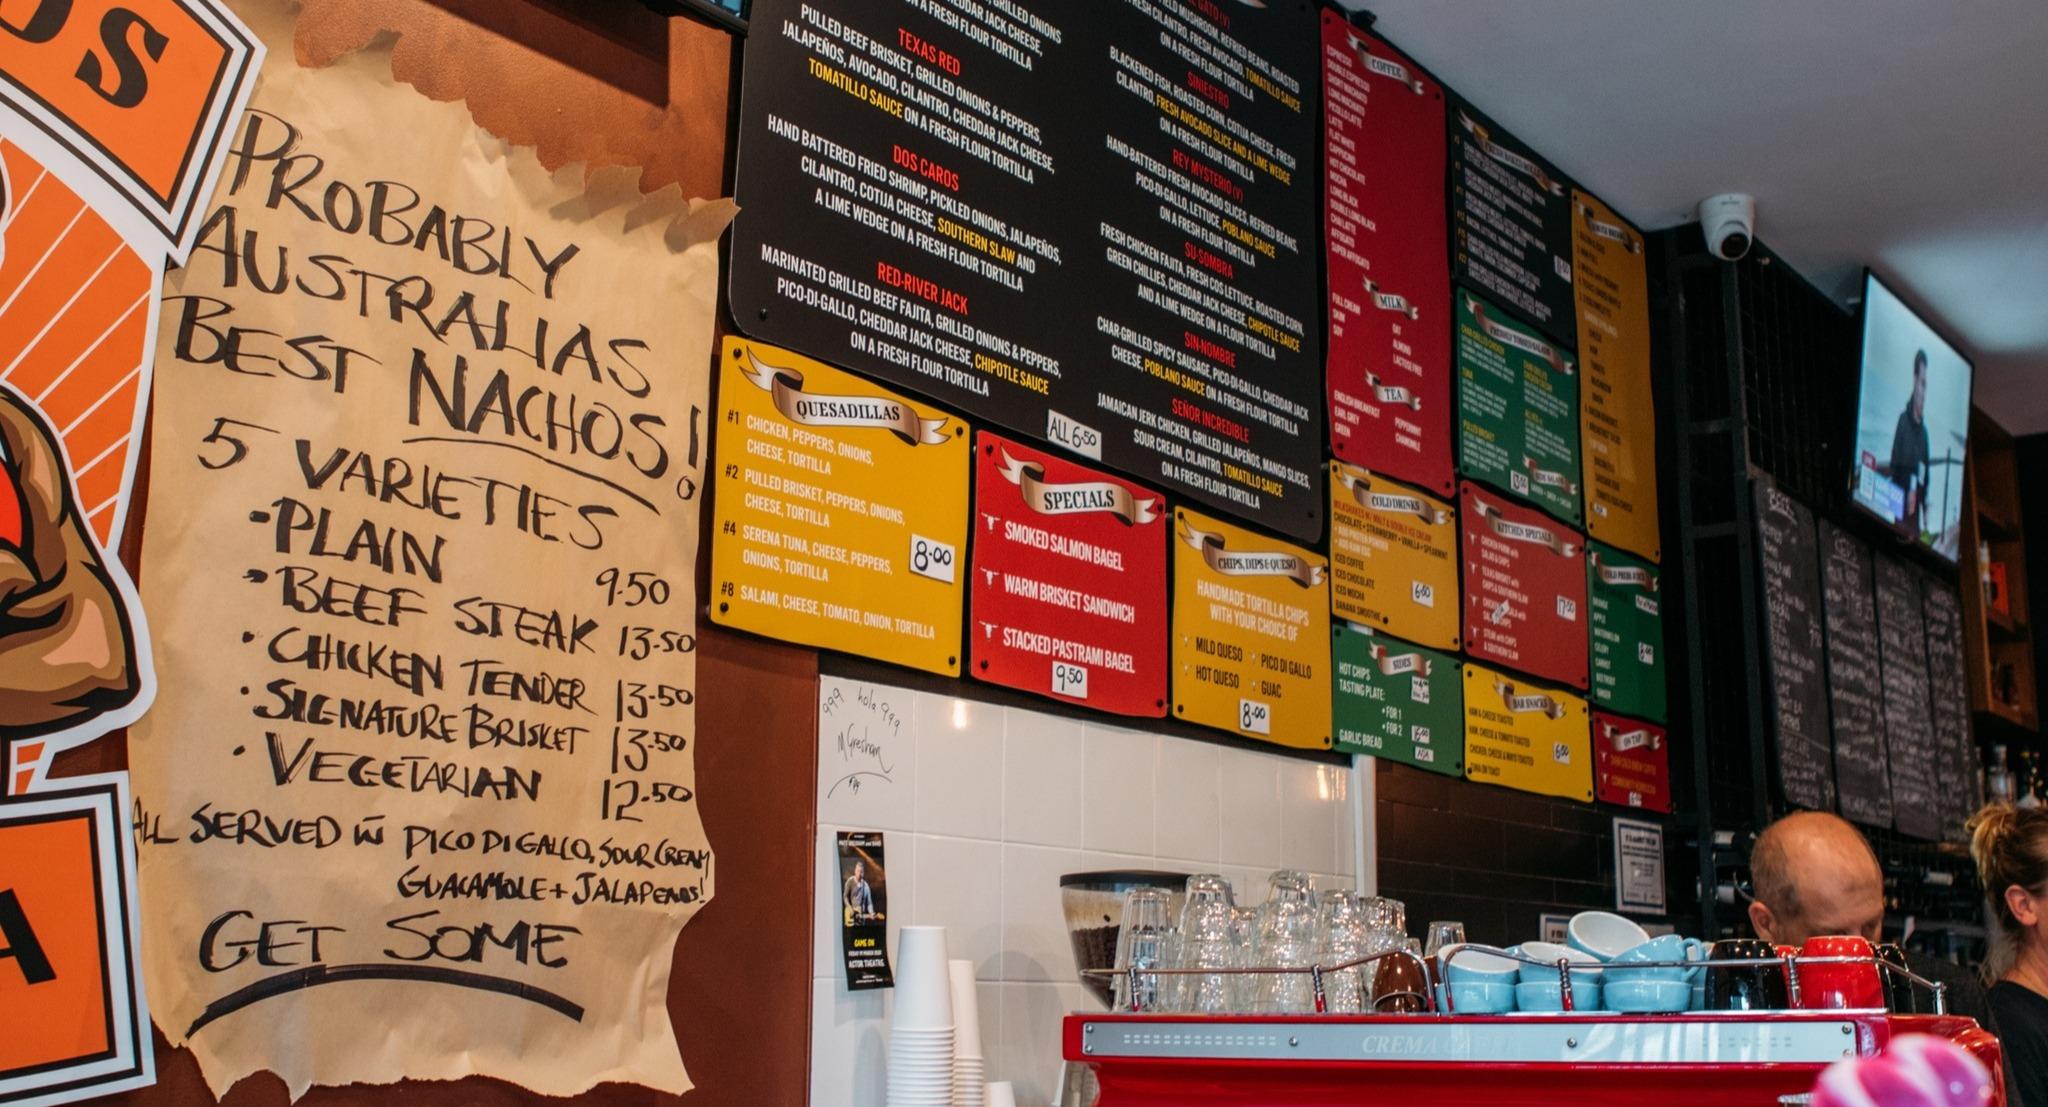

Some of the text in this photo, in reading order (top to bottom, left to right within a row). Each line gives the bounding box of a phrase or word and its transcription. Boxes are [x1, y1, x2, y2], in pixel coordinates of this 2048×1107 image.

[900, 28, 960, 77] TEXAS RED
[1372, 58, 1402, 78] COFFEE
[1186, 71, 1229, 109] SINIESTRO
[893, 144, 958, 191] DOS CAROS
[1172, 148, 1189, 171] REY
[1189, 158, 1232, 196] MYSTERIO
[229, 109, 579, 299] PROBABLY
[1136, 172, 1274, 258] PICO-DI-GALLO, LETTUCE, POBLANO SAUCE
[1184, 241, 1232, 278] SU-SOMBRA
[193, 205, 653, 399] AUSTRALIAS
[877, 261, 967, 314] RED-RIVER JACK
[1380, 296, 1402, 308] MILK
[161, 296, 382, 394] BEST
[777, 276, 1048, 395] PICO-DI-GALLO, CHEDDAR JACK CHEESE, CHIPOTLE SAUCE
[796, 400, 900, 422] QUESADILLAS
[1384, 389, 1402, 400] TEA
[728, 410, 874, 466] #1 CHICKEN, PEPPERS, ONIONS,
[1050, 416, 1070, 444] ALL
[1172, 399, 1248, 442] SEÑOR INCREDIBLE
[197, 417, 620, 549] 5 VARIETIES
[1133, 429, 1282, 496] SOUR CREAM, CILANTRO, TOMATILLO SAUCE
[726, 464, 904, 525] #2 PULLED BRISKET, PEPPERS, ONIONS,
[1044, 490, 1114, 510] SPECIALS
[1372, 496, 1420, 510] COLD DRINKS
[1004, 520, 1123, 571] SMOKED SALMON BAGEL
[1246, 558, 1264, 570] DIPS
[1270, 559, 1296, 570] QUESO
[276, 566, 428, 627] BEEF
[454, 596, 599, 654] STEAK
[721, 582, 734, 597] #8
[783, 594, 818, 616] CHEESE,
[824, 603, 861, 624] TOMATO,
[864, 611, 892, 631] ONION,
[896, 618, 934, 638] TORTILLA
[1004, 573, 1134, 623] WARM BRISKET SANDWICH
[1196, 579, 1308, 626] HANDMADE TORTILLA CHIPS
[1210, 603, 1297, 641] WITH YOUR CHOICE OF
[268, 627, 444, 696] CHICKEN
[460, 660, 599, 717] TENDER
[1002, 627, 1133, 673] STACKED PASTRAMI BAGEL
[1196, 637, 1242, 662] MILD QUESO
[1260, 654, 1311, 679] PICO DI GALLO
[1338, 660, 1370, 681] HOT CHIPS
[1392, 657, 1411, 670] SIDES
[1195, 664, 1239, 689] HOT QUESO
[1260, 680, 1281, 698] GUAC
[1339, 678, 1364, 696] TASTING
[253, 678, 459, 743] SIGNATURE
[463, 703, 590, 754] BRISKET
[1386, 706, 1397, 718] FOR
[1386, 722, 1397, 735] FOR
[1398, 725, 1402, 736] 2
[1339, 729, 1382, 749] GARLIC BREAD
[265, 732, 542, 801] VEGETARIAN
[190, 802, 342, 849] SERVED
[403, 826, 476, 860] PICO
[599, 837, 655, 868] SOUR
[654, 838, 710, 880] CREAM
[199, 910, 583, 972] GET SOME
[854, 939, 875, 947] GAME ON
